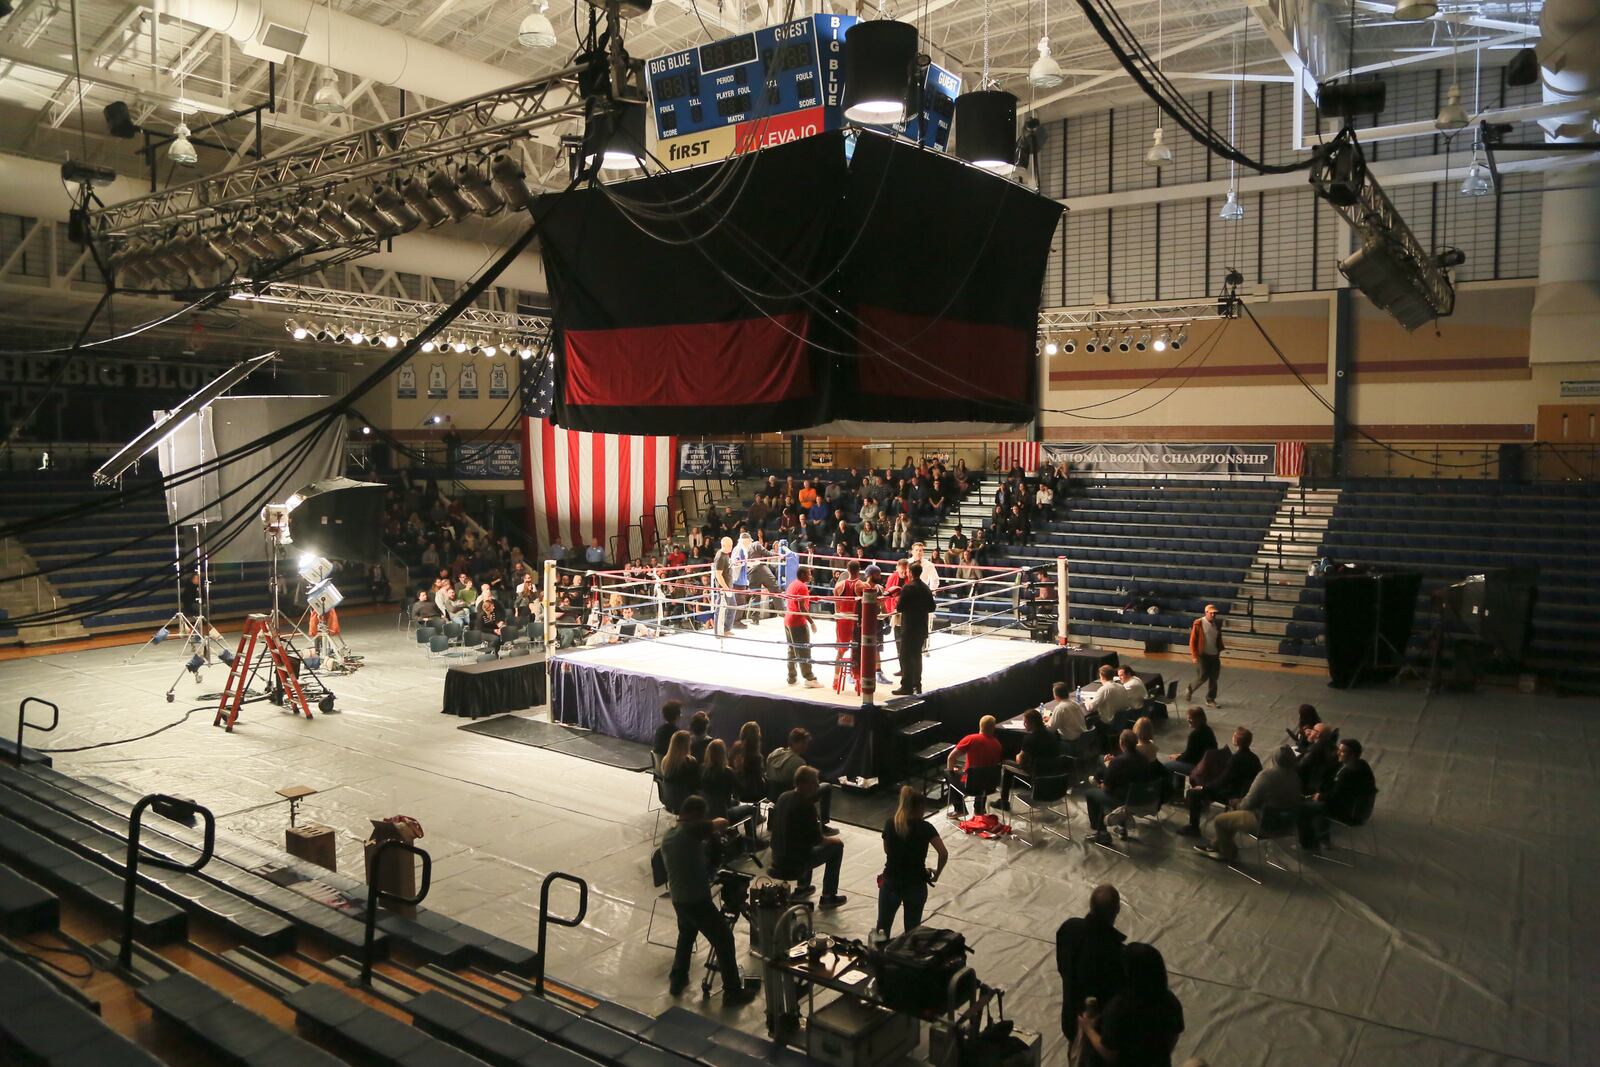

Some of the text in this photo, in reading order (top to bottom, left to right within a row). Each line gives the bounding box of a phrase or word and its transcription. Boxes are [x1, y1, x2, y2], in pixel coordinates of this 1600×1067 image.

[650, 52, 691, 74] BIG BLUE
[828, 16, 840, 106] BIG BLUE
[716, 75, 735, 86] PERIOD
[795, 71, 813, 82] FOULS
[938, 71, 958, 92] GUEST
[716, 86, 751, 100] PLAYER FOUL
[798, 97, 816, 108] SCORE
[659, 104, 675, 114] FOULS
[727, 113, 745, 124] MATCH
[663, 128, 678, 138] SCORE
[62, 360, 126, 387] BIG
[1047, 453, 1269, 465] NATIONAL BOXING CHAMPIONSHIP
